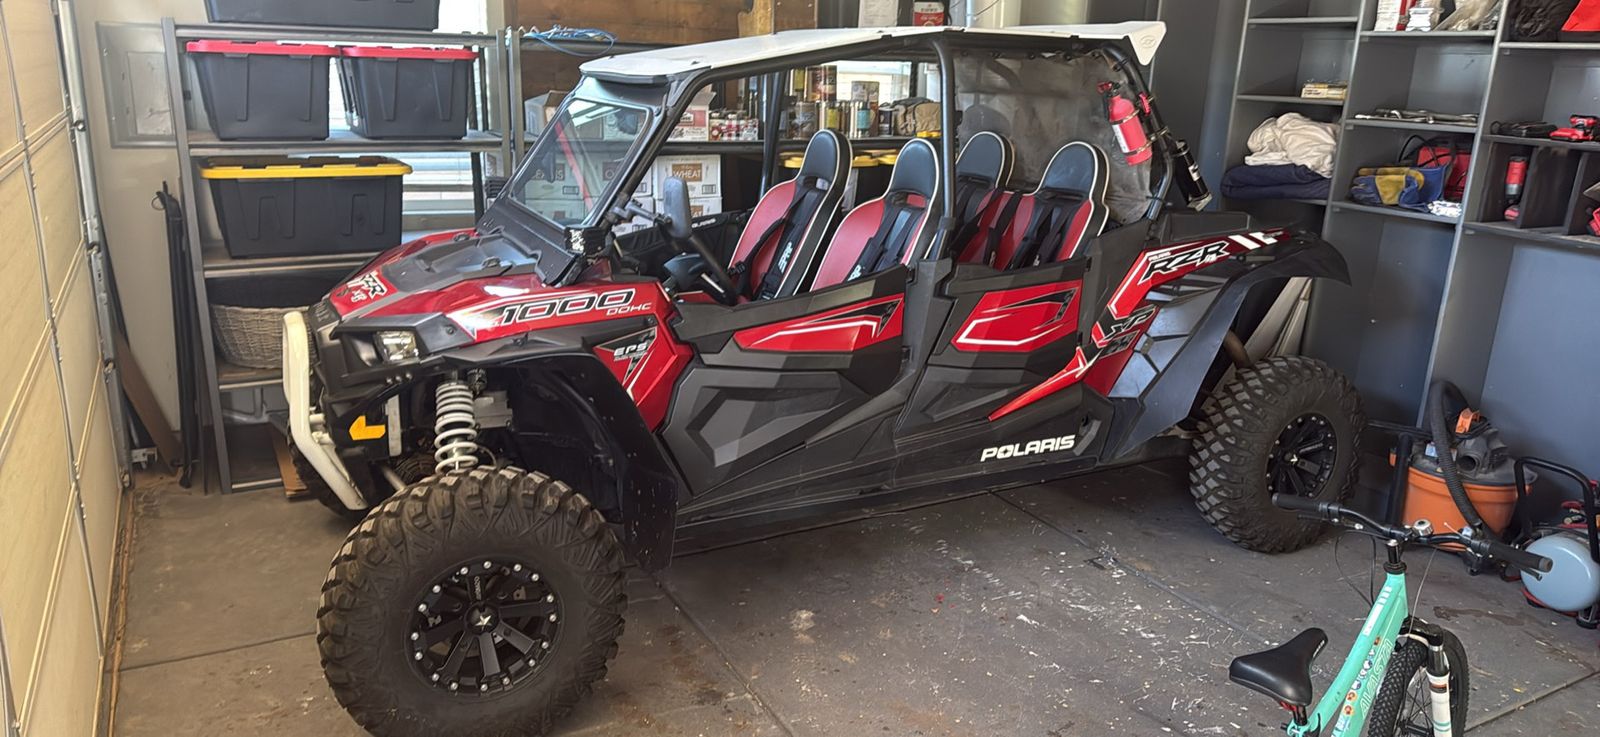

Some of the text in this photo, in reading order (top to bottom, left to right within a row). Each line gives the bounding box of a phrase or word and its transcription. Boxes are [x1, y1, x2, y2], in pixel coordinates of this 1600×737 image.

[673, 169, 702, 179] WHEAT
[1137, 240, 1231, 286] RZR
[501, 287, 636, 327] 1000
[606, 302, 652, 316] DOHC
[614, 342, 648, 356] EPS
[980, 435, 1076, 463] POLARIS
